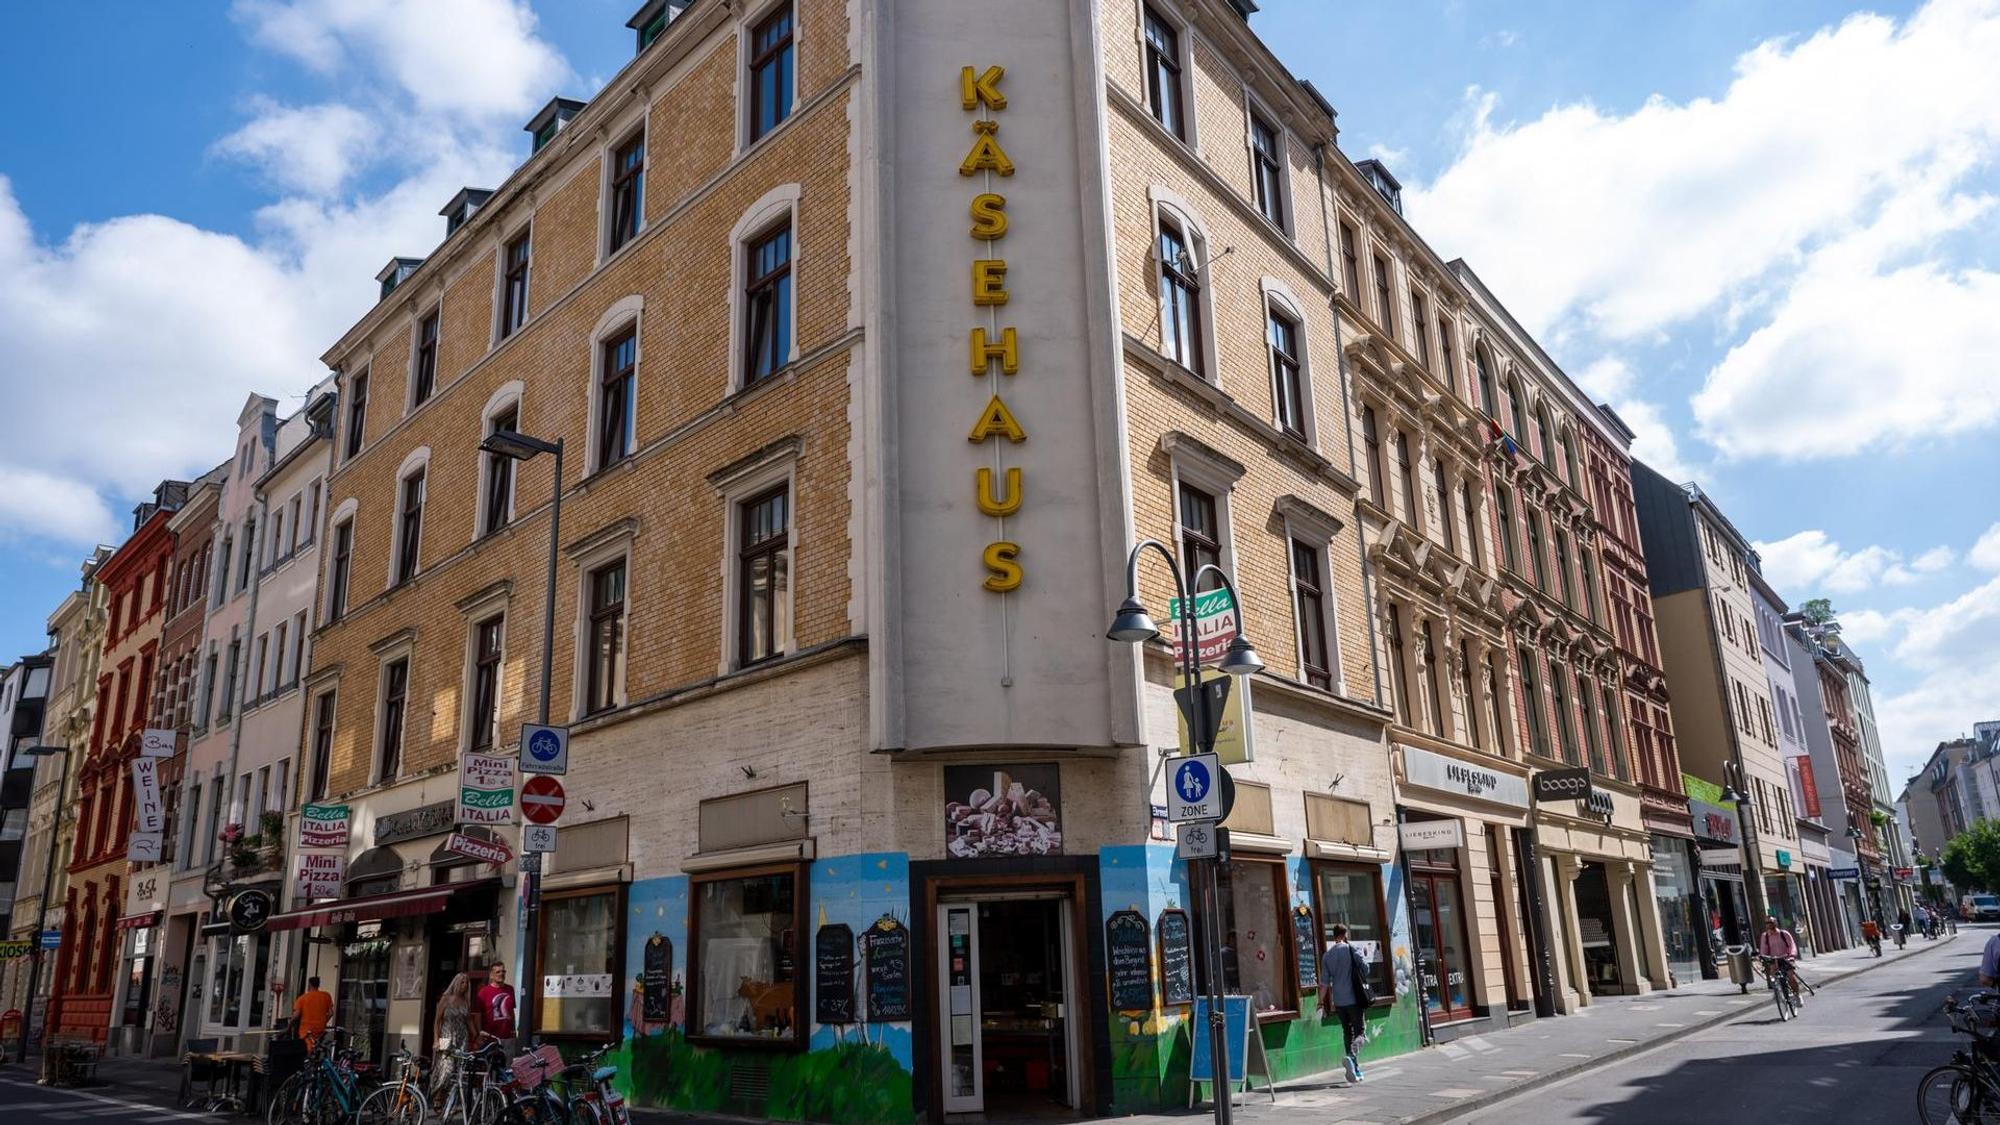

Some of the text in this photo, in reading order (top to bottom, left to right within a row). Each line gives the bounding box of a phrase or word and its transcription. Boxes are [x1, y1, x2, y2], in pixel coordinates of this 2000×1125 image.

[959, 66, 1028, 592] KÄSEHAUS
[473, 759, 508, 769] Mini
[467, 767, 512, 777] Pizza
[1540, 776, 1587, 795] boogs
[138, 762, 158, 828] WEINE
[464, 790, 510, 807] Bella
[306, 806, 346, 820] Bella
[462, 808, 511, 822] ITALIA
[1181, 804, 1208, 817] ZONE
[303, 821, 346, 832] ITALIA
[302, 835, 346, 845] Pizzeria
[535, 842, 546, 850] frei
[453, 836, 507, 862] Pizzeria
[1190, 845, 1203, 854] frei
[306, 855, 337, 868] Mini
[299, 869, 339, 881] Pizza
